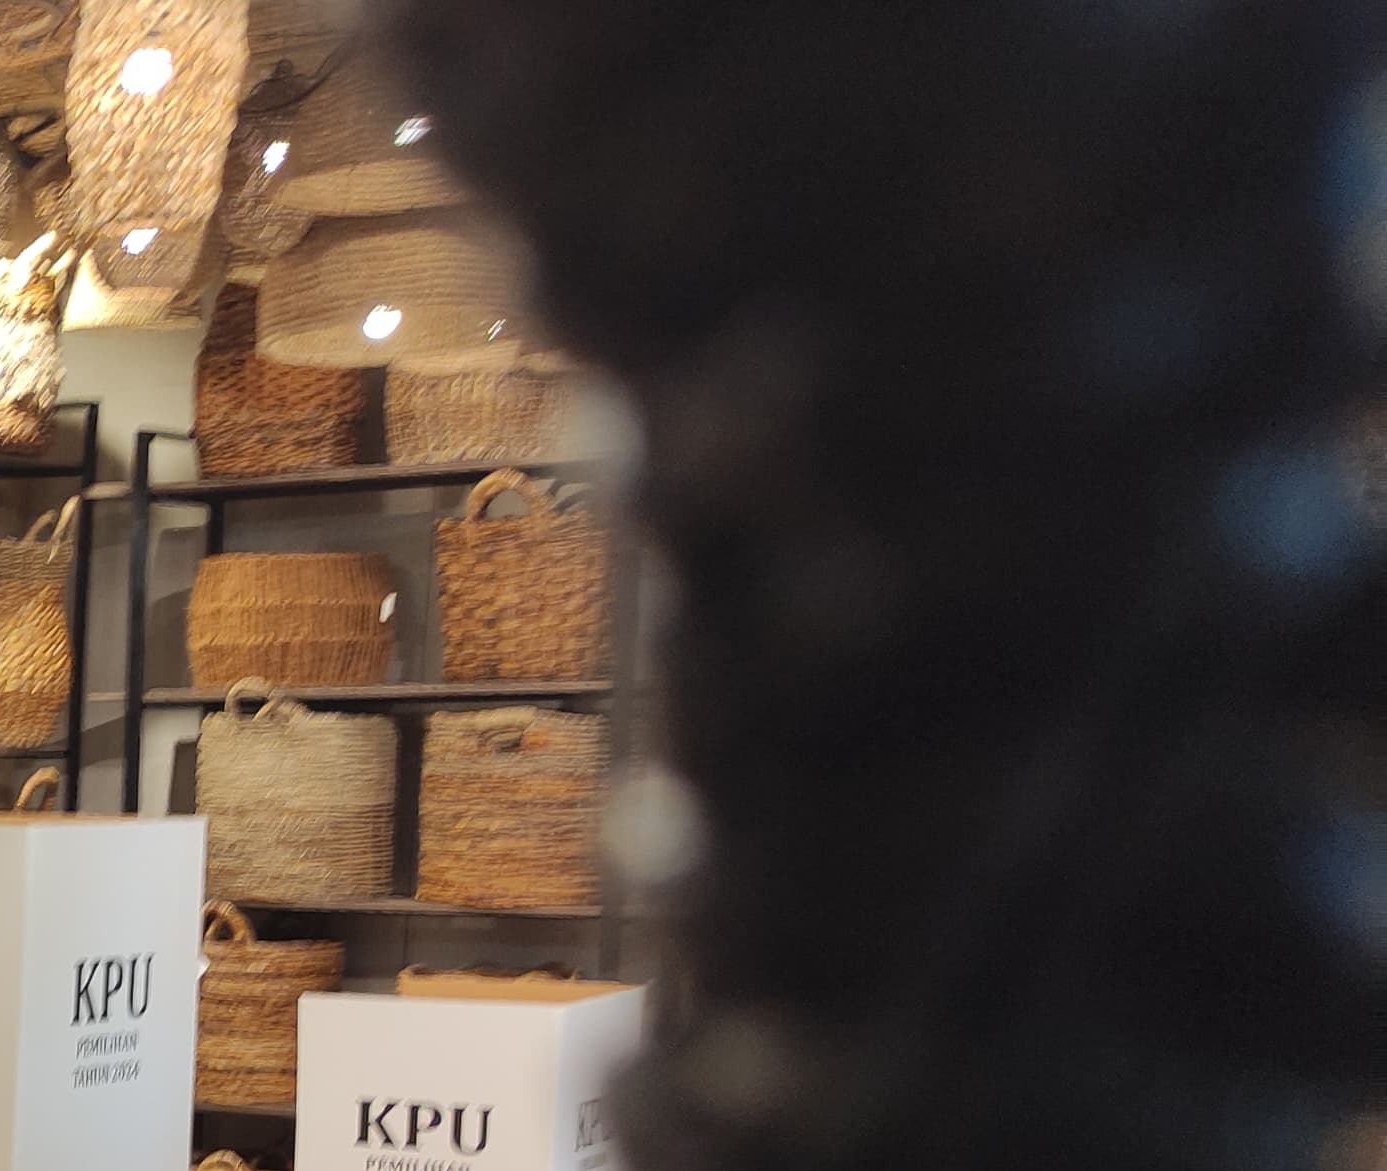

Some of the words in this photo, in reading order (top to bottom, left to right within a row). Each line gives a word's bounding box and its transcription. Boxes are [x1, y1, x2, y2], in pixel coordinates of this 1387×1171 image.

[70, 952, 156, 1027] KPU
[75, 1030, 138, 1059] PEMILIHAN
[73, 1064, 109, 1088] TAHUN
[354, 1095, 496, 1157] KPU
